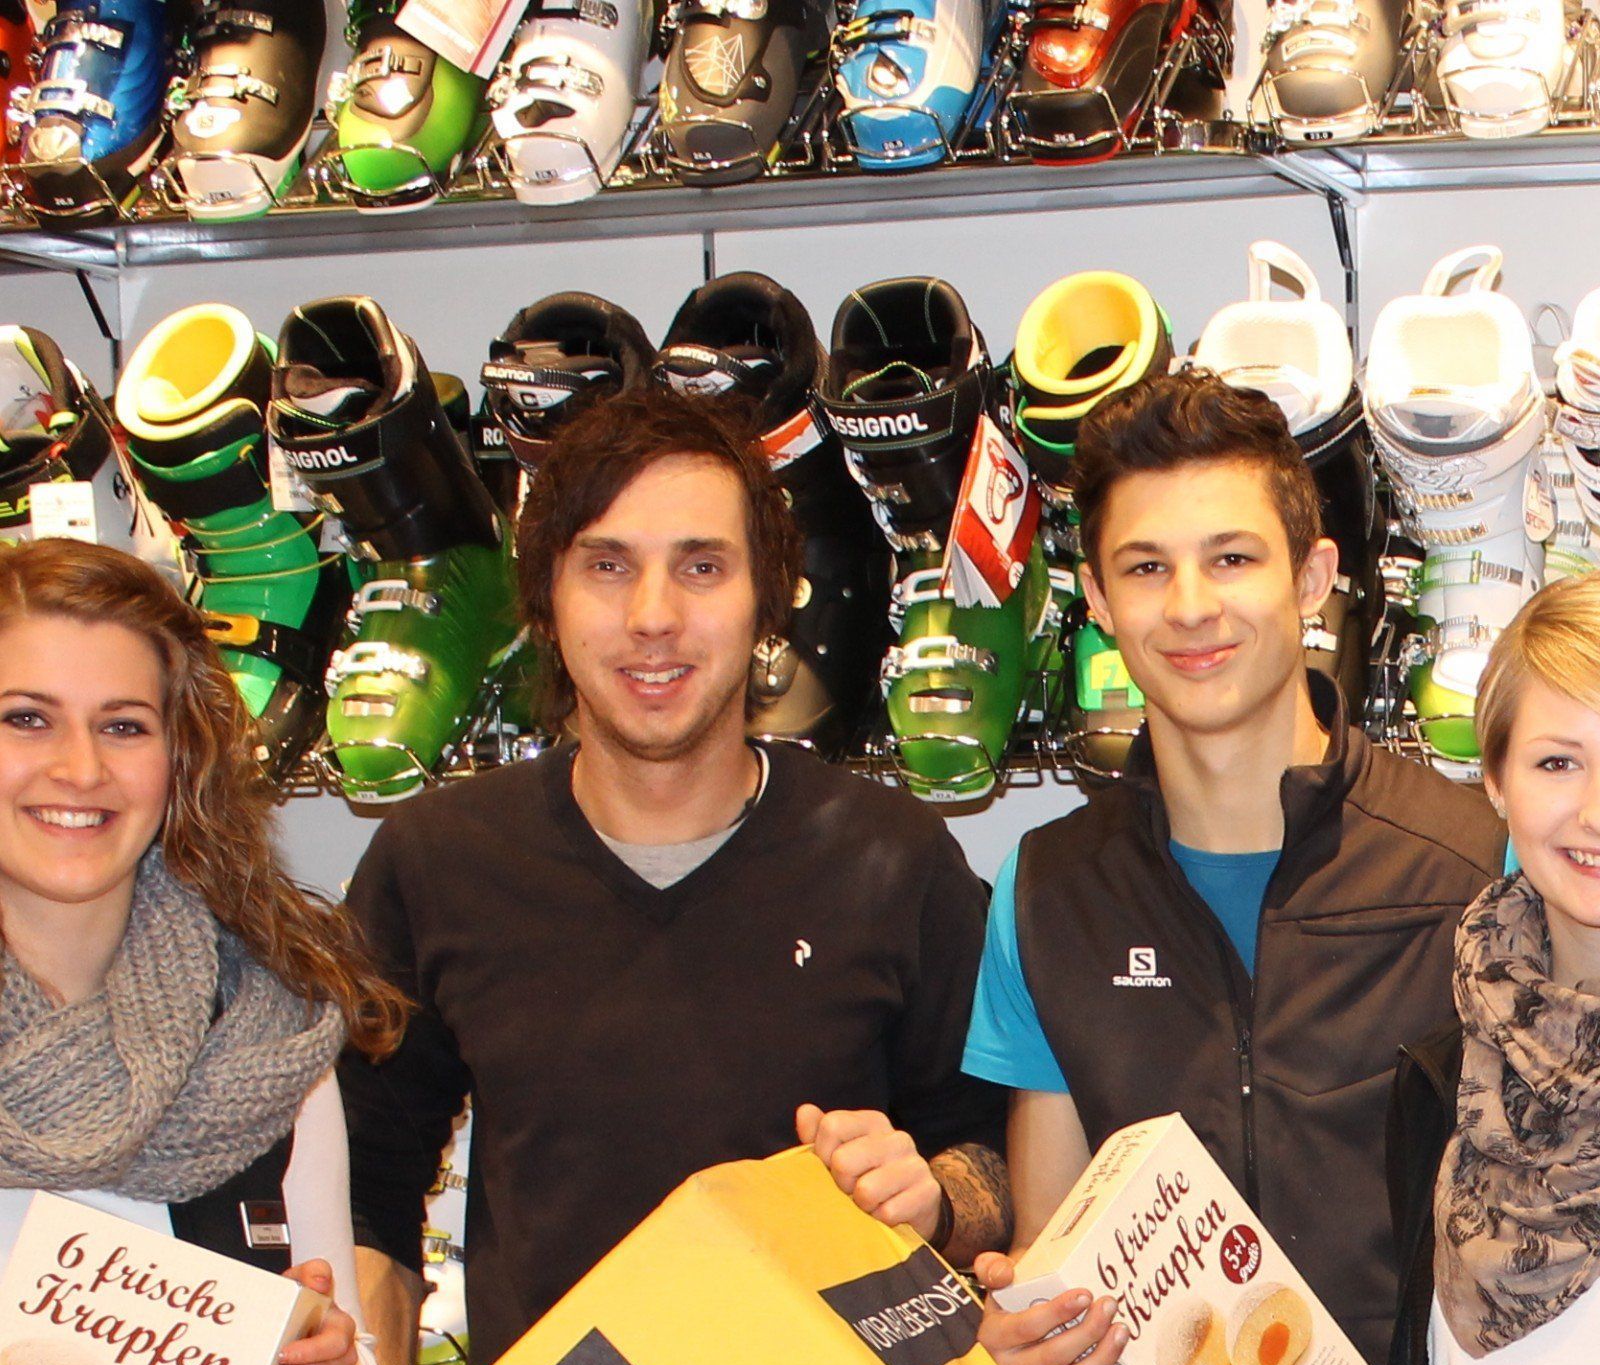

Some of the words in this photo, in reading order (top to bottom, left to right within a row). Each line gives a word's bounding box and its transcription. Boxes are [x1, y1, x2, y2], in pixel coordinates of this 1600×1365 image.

[483, 427, 507, 445] RO
[1113, 975, 1172, 987] salomon
[1097, 1251, 1118, 1290] 6
[1114, 1171, 1190, 1278] frische
[1224, 1229, 1246, 1269] 5+1
[57, 1232, 91, 1269] 6
[90, 1246, 236, 1326] frische
[1117, 1199, 1226, 1341] Krapfen
